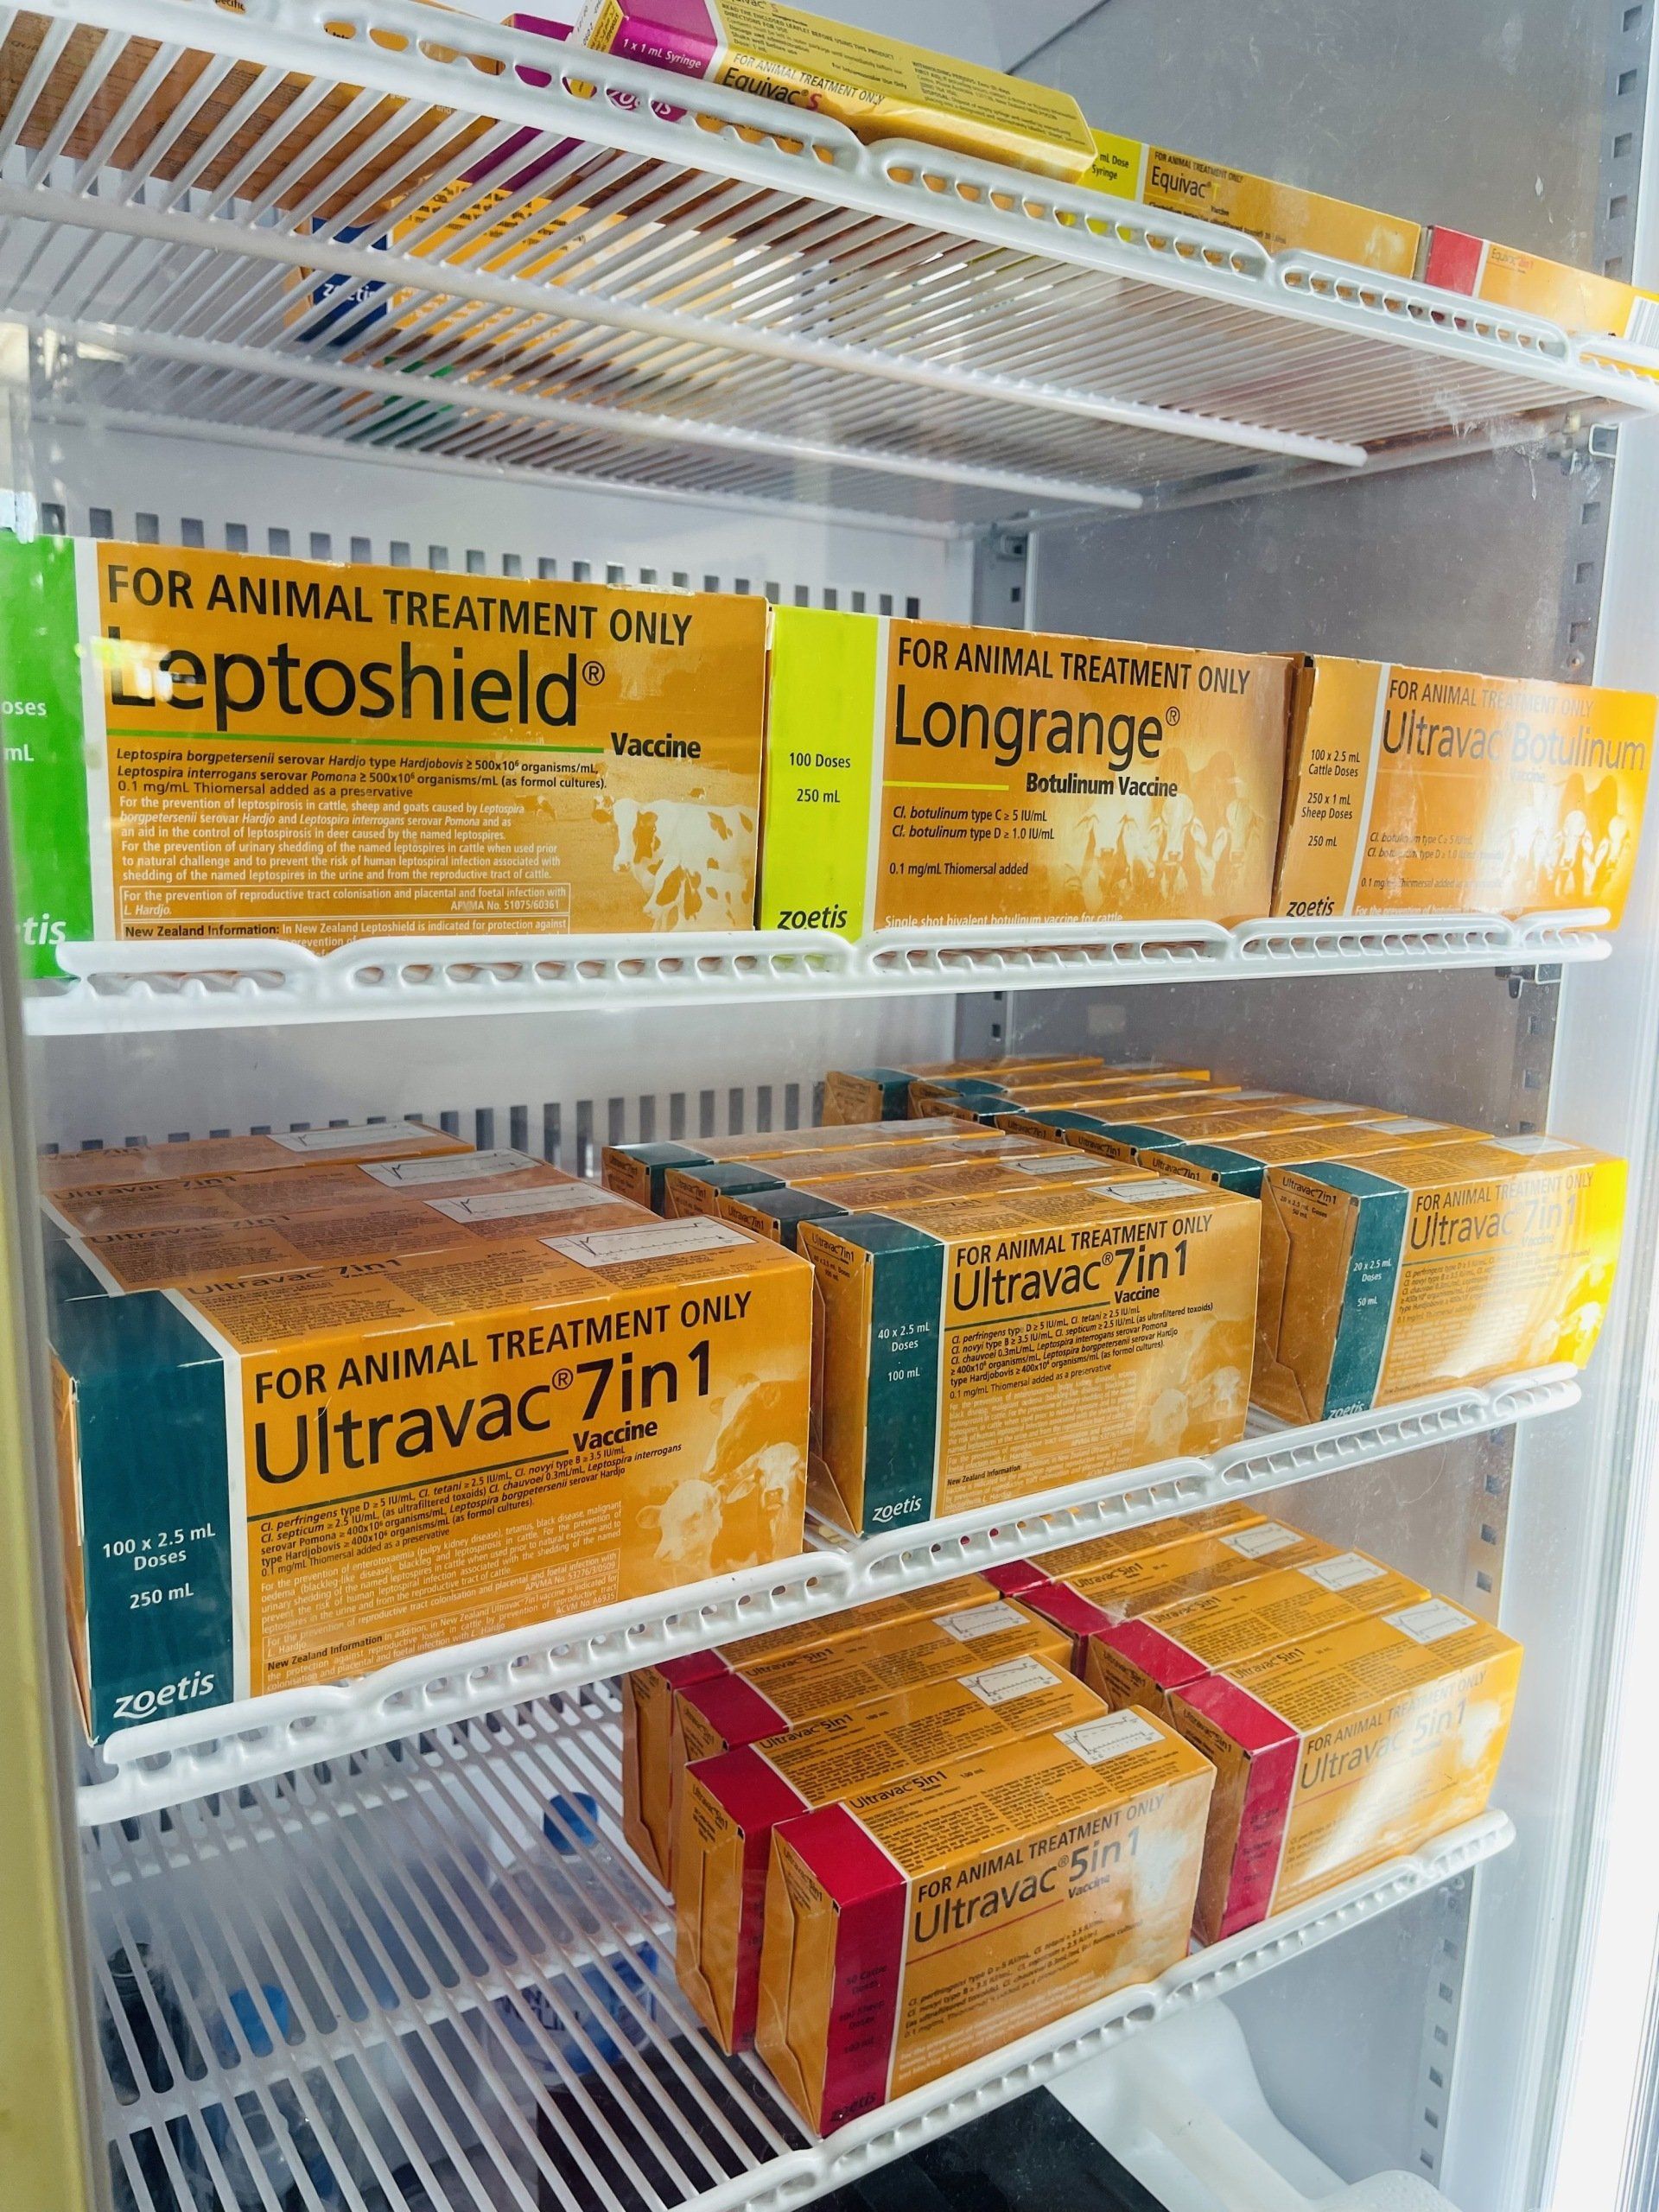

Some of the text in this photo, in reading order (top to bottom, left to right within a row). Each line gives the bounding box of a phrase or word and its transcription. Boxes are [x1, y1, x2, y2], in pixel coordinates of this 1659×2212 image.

[623, 38, 701, 69] 1 x 1 mL Syringe
[734, 53, 753, 67] FOR
[756, 59, 797, 79] ANIMAL
[800, 72, 863, 99] TREATMENT
[1092, 164, 1117, 181] Syringe
[1112, 156, 1129, 168] Dose
[1155, 151, 1243, 183] FOR ANIMAL TREATMENT ONLY
[107, 564, 692, 647] FOR ANIMAL TREATMENT ONLY
[898, 636, 1250, 695] FOR ANIMAL TREATMENT ONLY
[1389, 679, 1596, 719] FOR ANIMAL TREATMENT ONLY
[610, 733, 702, 759] Vaccine
[1311, 749, 1361, 763] 100 x 2.5 mL
[1510, 721, 1647, 772] Botulinum
[117, 748, 183, 764] Leptospira
[187, 750, 275, 766] borgpetersenii
[277, 755, 326, 766] serovar
[328, 754, 366, 769] Hardjo
[369, 757, 397, 769] type
[399, 758, 465, 771] Hardjobovis
[521, 762, 599, 775] organisms/mL,
[788, 752, 851, 769] 100 Doses
[1308, 764, 1358, 777] Cattle Doses
[118, 780, 138, 792] 0.1
[143, 780, 189, 795] mg/mL
[194, 782, 265, 796] Thiomersal
[270, 784, 311, 796] added
[314, 786, 327, 797] as
[340, 786, 413, 800] preservative
[796, 788, 840, 804] 250 mL
[1027, 772, 1178, 798] Botulinum Vaccine
[1307, 792, 1351, 805] 250 x 1 mL
[910, 807, 968, 820] botulinum
[971, 809, 993, 823] type
[995, 810, 1001, 820] C
[1013, 810, 1019, 820] 5
[1021, 810, 1047, 822] IU/mL
[1301, 806, 1352, 821] Sheep Doses
[1308, 836, 1338, 847] 250 mL
[889, 862, 1028, 877] 0.1 mg/mL Thiomersal added
[124, 887, 391, 903] For the prevention of reproductive tract colonisation
[1286, 896, 1335, 917] zoetis
[777, 904, 848, 931] zoetis
[125, 924, 280, 938] New Zealand Information:
[1416, 1173, 1593, 1212] FOR ANIMAL TREATMENT ONLY
[1524, 1193, 1577, 1232] 7in1
[956, 1214, 1214, 1268] FOR ANIMAL TREATMENT ONLY
[1114, 1239, 1187, 1287] 7in1
[1353, 1262, 1362, 1272] 20
[1370, 1260, 1381, 1269] 2.5
[1362, 1273, 1382, 1282] Doses
[1115, 1286, 1160, 1304] Vaccine
[1357, 1296, 1378, 1306] 50 mL
[878, 1328, 890, 1339] 40
[900, 1325, 914, 1336] 2.5
[917, 1321, 930, 1332] mL
[255, 1291, 753, 1406] FOR ANIMAL TREATMENT ONLY
[892, 1339, 918, 1351] Doses
[574, 1338, 712, 1422] 7in1
[888, 1366, 920, 1382] 100 mL
[573, 1417, 658, 1454] Vaccine
[872, 1495, 921, 1522] zoetis
[103, 1522, 215, 1558] 100 x 2.5 mL
[134, 1549, 187, 1571] Doses
[130, 1582, 194, 1610] 250 mL
[113, 1670, 214, 1719] zoetis
[821, 1714, 854, 1733] 5in1
[1306, 1670, 1486, 1755] FOR ANIMAL ONLY
[912, 1770, 949, 1790] 5in1
[918, 1793, 1164, 1903] FOR ANIMAL TREATMENT ONLY
[1069, 1826, 1141, 1884] 5in1
[1068, 1874, 1110, 1899] Vaccine
